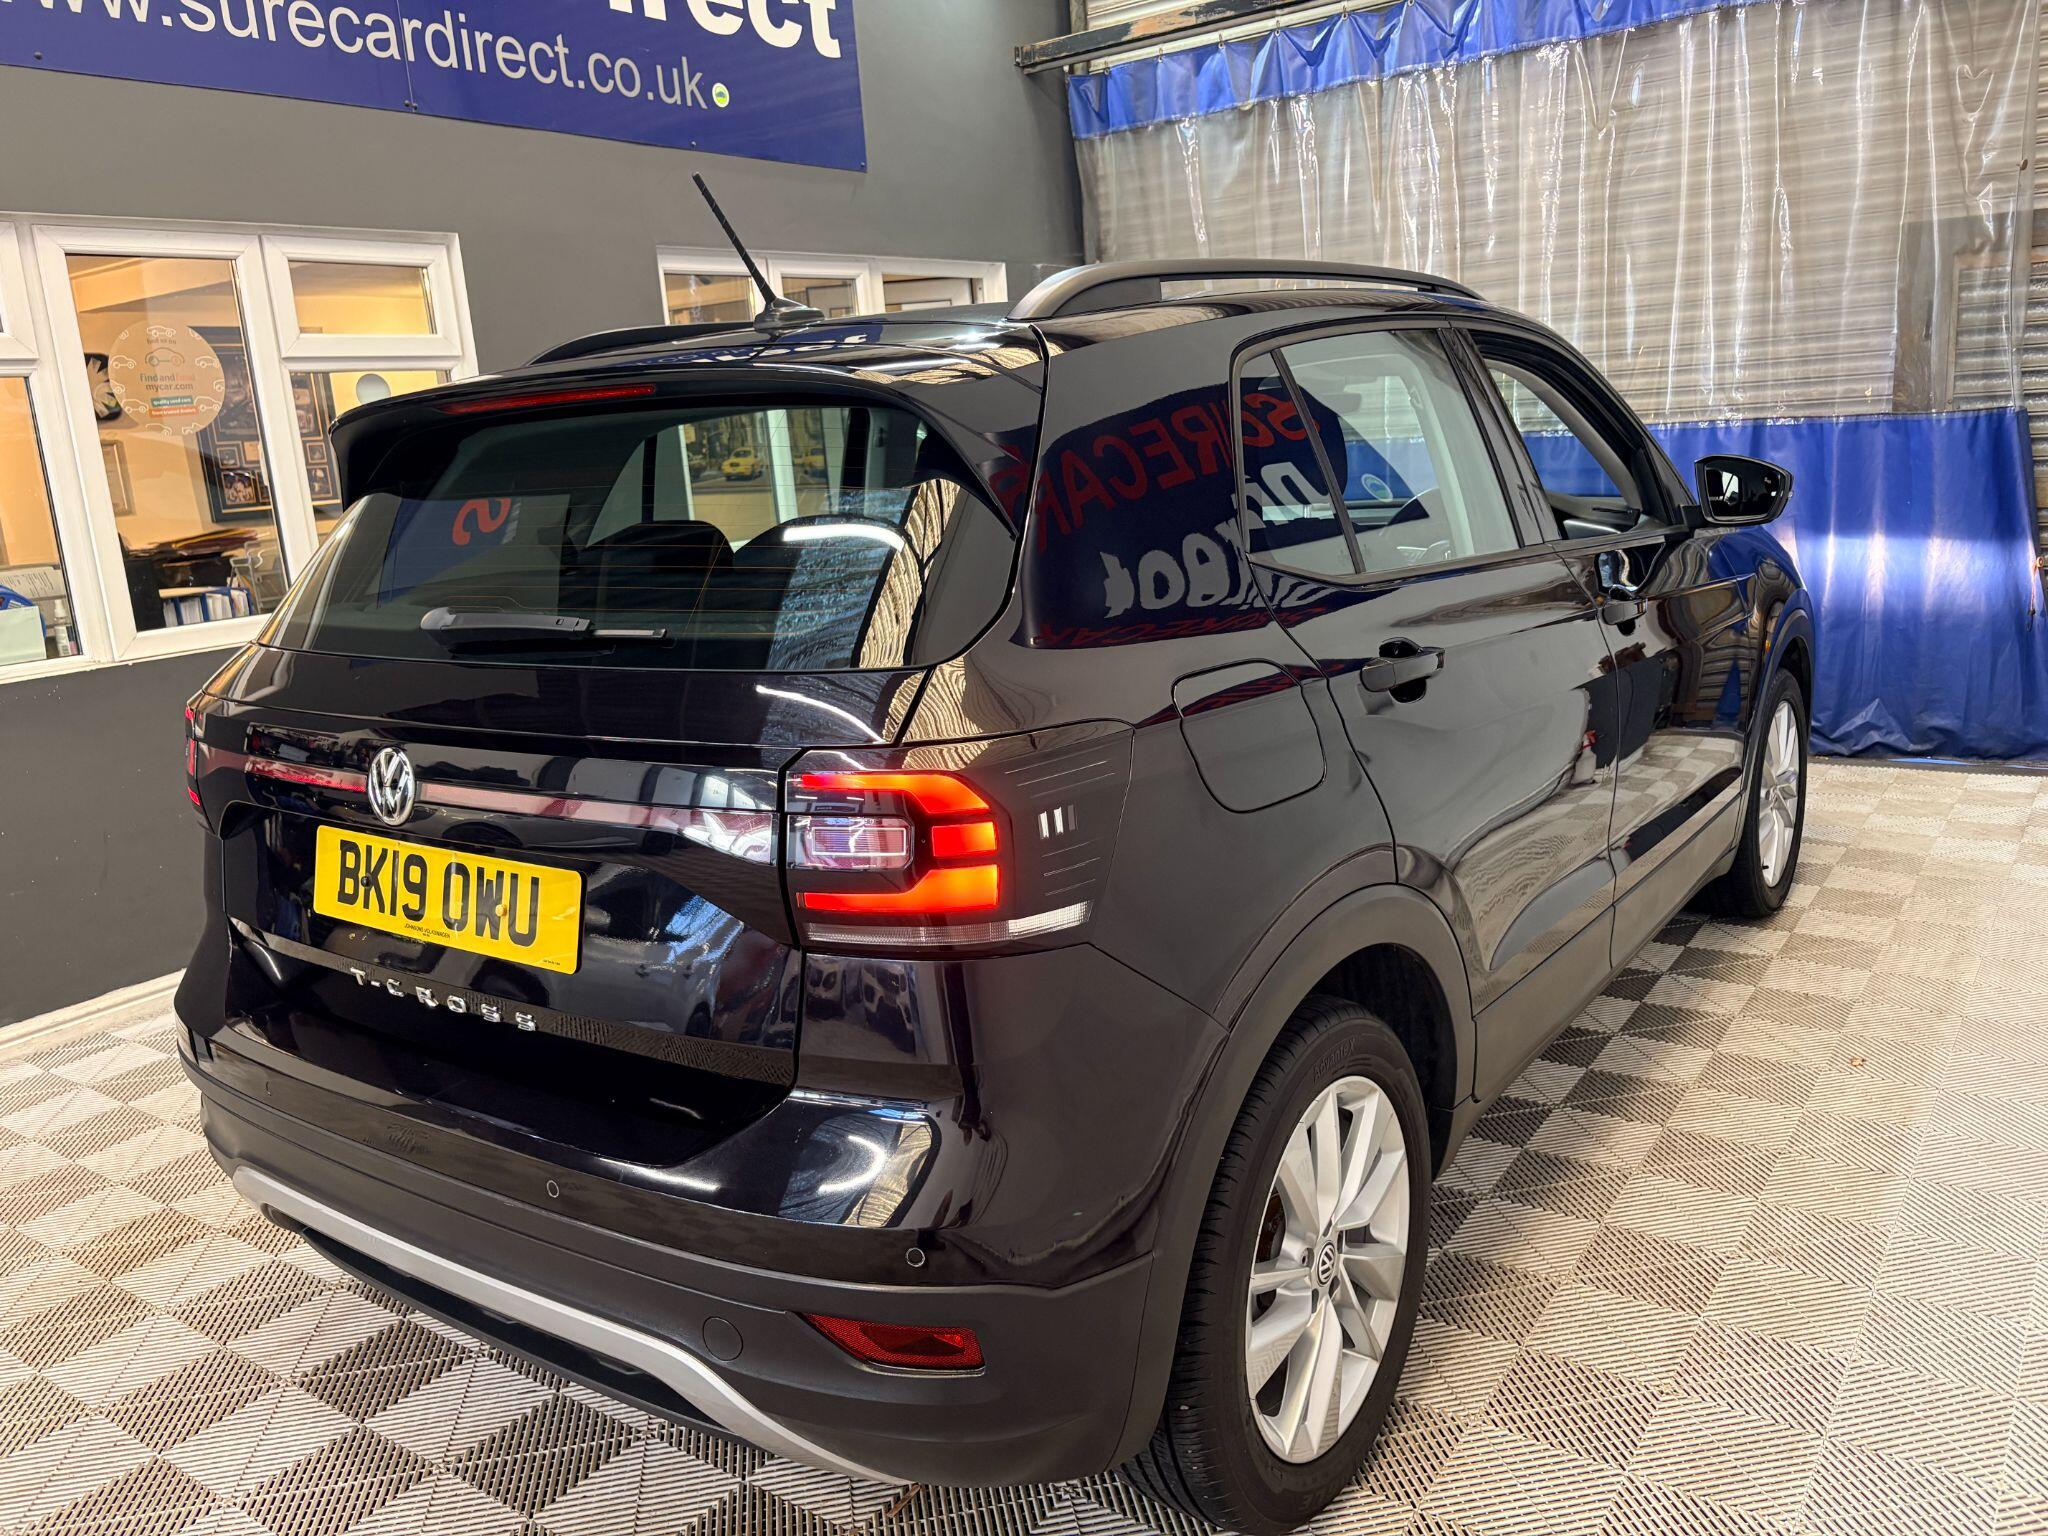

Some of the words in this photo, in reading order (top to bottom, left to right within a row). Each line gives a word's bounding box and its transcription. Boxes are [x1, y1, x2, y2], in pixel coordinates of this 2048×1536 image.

[0, 0, 708, 109] .surecardirect.co.uk
[337, 839, 427, 922] BK19
[442, 861, 540, 947] OWU
[350, 966, 537, 1031] T-CROSS
